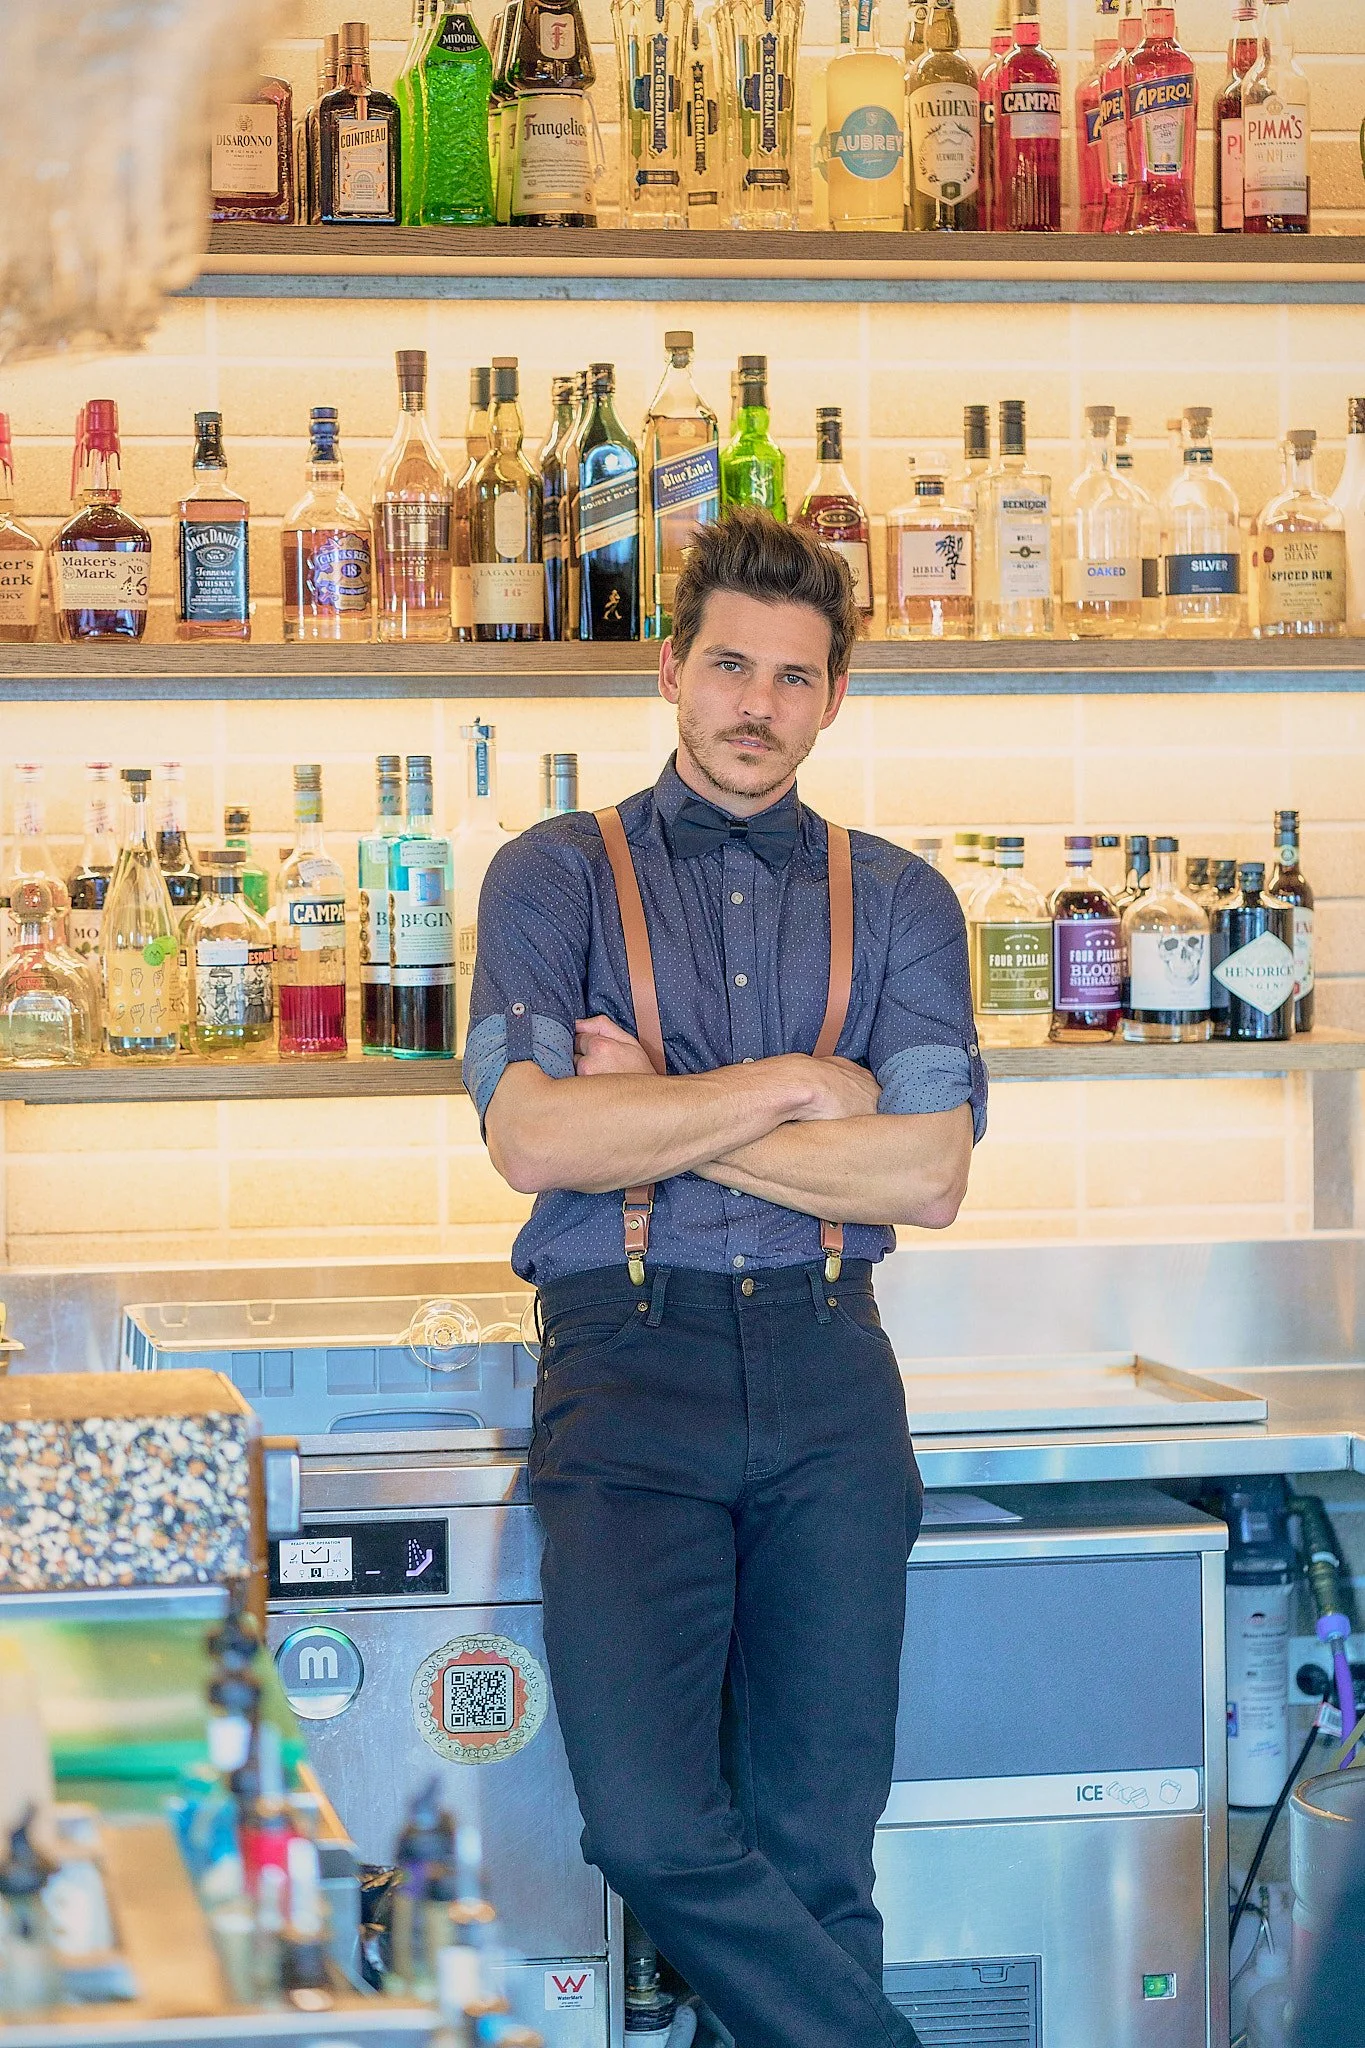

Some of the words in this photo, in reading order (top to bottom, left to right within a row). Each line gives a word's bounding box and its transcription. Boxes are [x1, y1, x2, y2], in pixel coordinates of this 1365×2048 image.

[442, 33, 478, 44] MIDORI
[655, 55, 665, 129] ST-GERMAIN
[763, 54, 774, 129] ST-GERMAIN
[1135, 81, 1192, 113] APEROL
[693, 82, 706, 153] ST-GERMAIN
[1248, 115, 1303, 141] PIMM'S
[216, 134, 272, 148] DISARONNO
[340, 127, 386, 149] COINTREAU
[835, 134, 902, 152] AUBREY
[660, 471, 687, 489] Blue
[684, 460, 713, 480] Label
[386, 505, 446, 516] GLENMORANGIE
[581, 496, 613, 512] DOUBLE
[186, 532, 210, 552] JACK
[1289, 543, 1313, 552] RUM
[62, 556, 117, 567] Maker's
[1284, 551, 1317, 561] DIARY
[196, 567, 236, 577] Tennessee
[346, 565, 358, 576] 18
[912, 566, 945, 574] HIBIKI
[1087, 567, 1127, 577] OAKED
[1190, 560, 1229, 572] SILVER
[75, 569, 115, 579] Mark
[1271, 571, 1309, 581] SPICED
[503, 588, 522, 597] 16
[989, 954, 1013, 967] FOUR
[1016, 953, 1048, 967] PILLARS
[1069, 950, 1094, 962] FOUR
[460, 1640, 508, 1652] HACCP
[510, 1650, 540, 1690] FORMS
[418, 1654, 445, 1697] FORMS
[419, 1702, 445, 1744] HACCP
[503, 1711, 537, 1750] HACCP
[453, 1744, 499, 1758] FORMS
[1076, 1785, 1103, 1801] ICE
